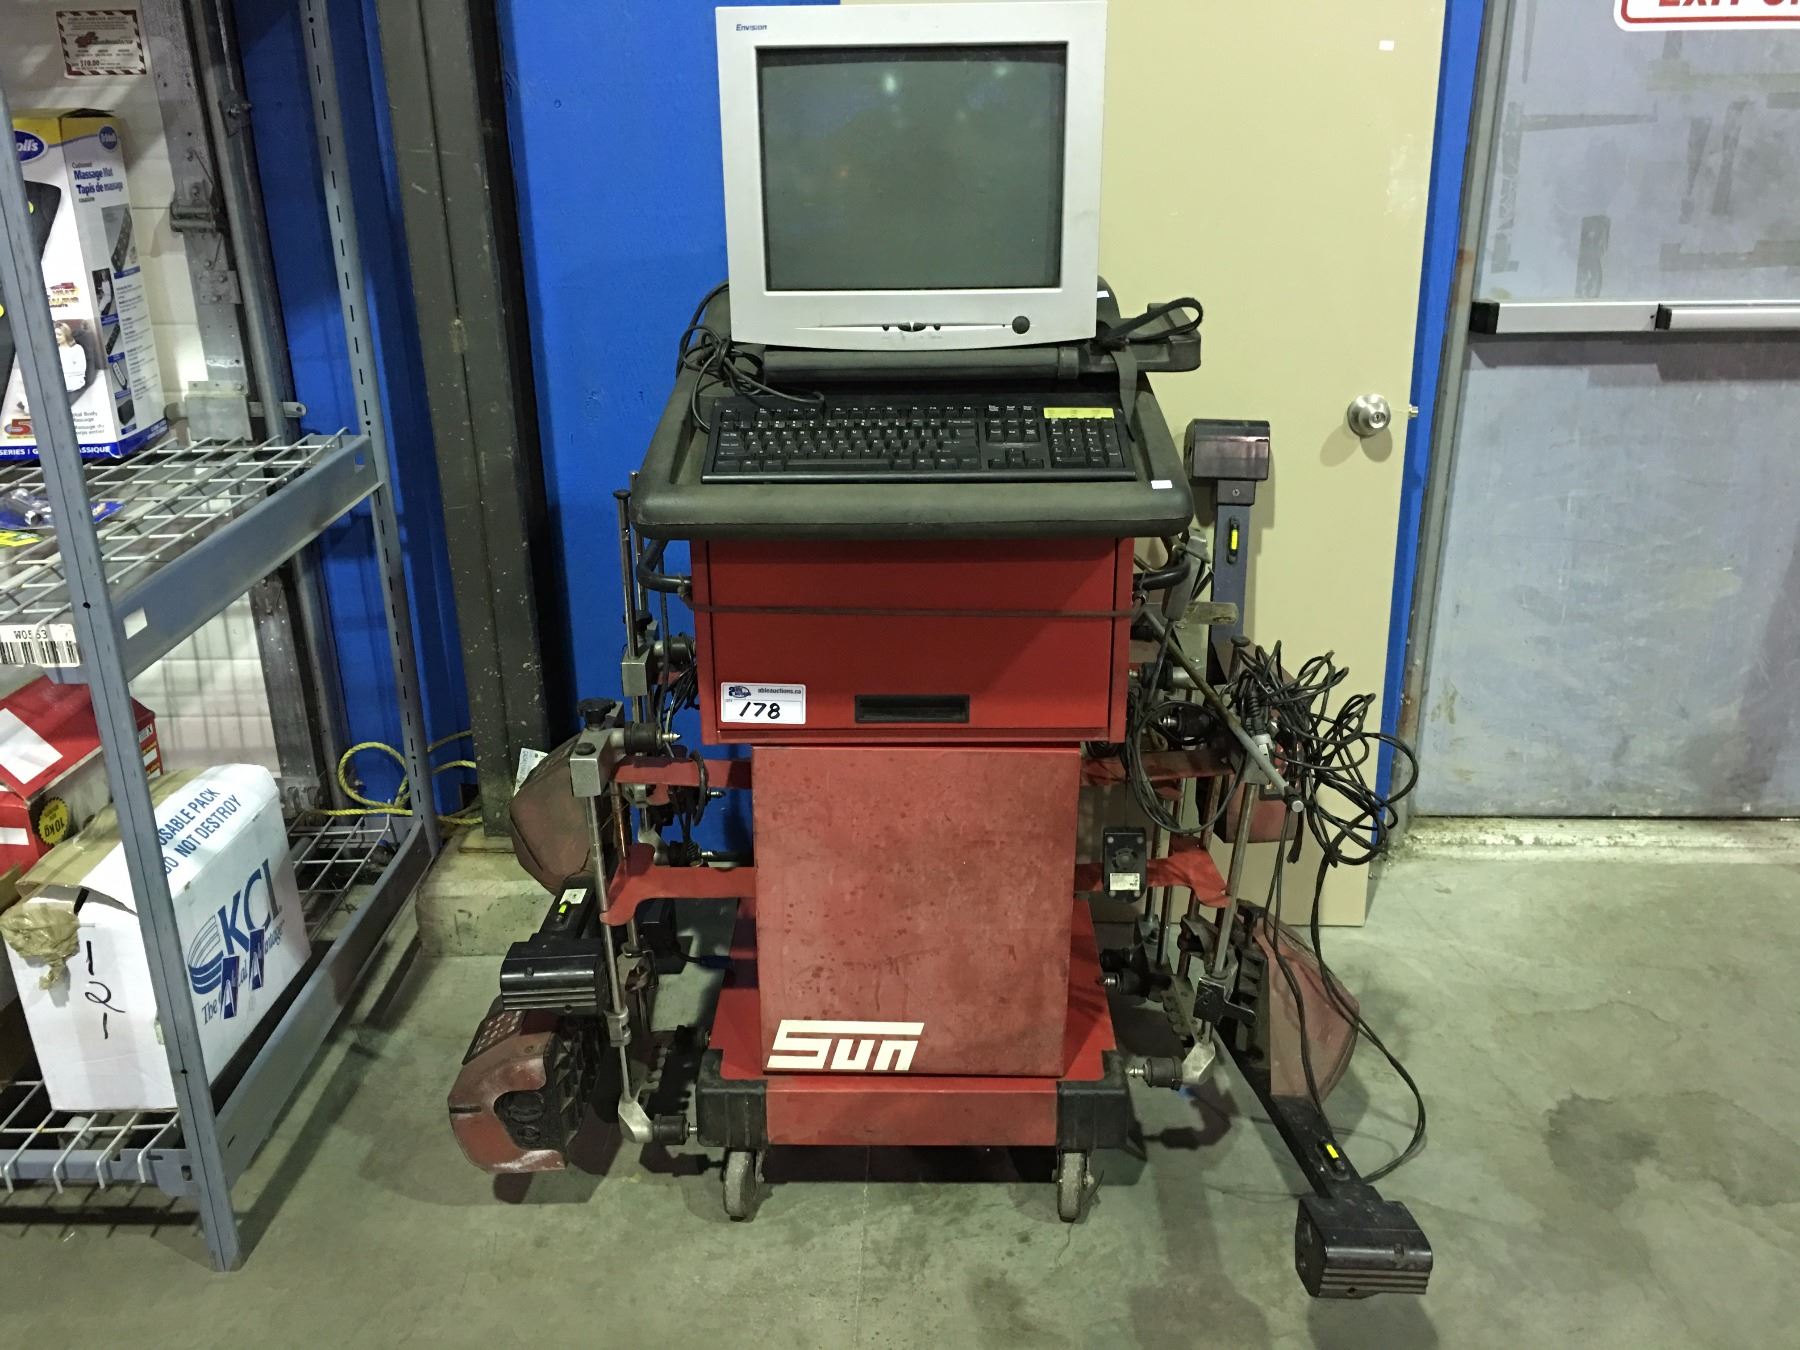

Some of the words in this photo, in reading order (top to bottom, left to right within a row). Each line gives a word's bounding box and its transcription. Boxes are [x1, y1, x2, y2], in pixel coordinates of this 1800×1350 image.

[735, 23, 768, 31] Envision
[15, 138, 39, 152] oll's
[73, 169, 103, 182] Massage
[76, 182, 95, 196] Tapis
[96, 181, 104, 192] de
[0, 448, 26, 456] SERIES
[739, 701, 780, 720] 178
[187, 783, 221, 815] PACK
[174, 832, 202, 860] NOT
[192, 794, 244, 841] DESTROY
[217, 858, 281, 956] KCI
[201, 996, 219, 1026] The
